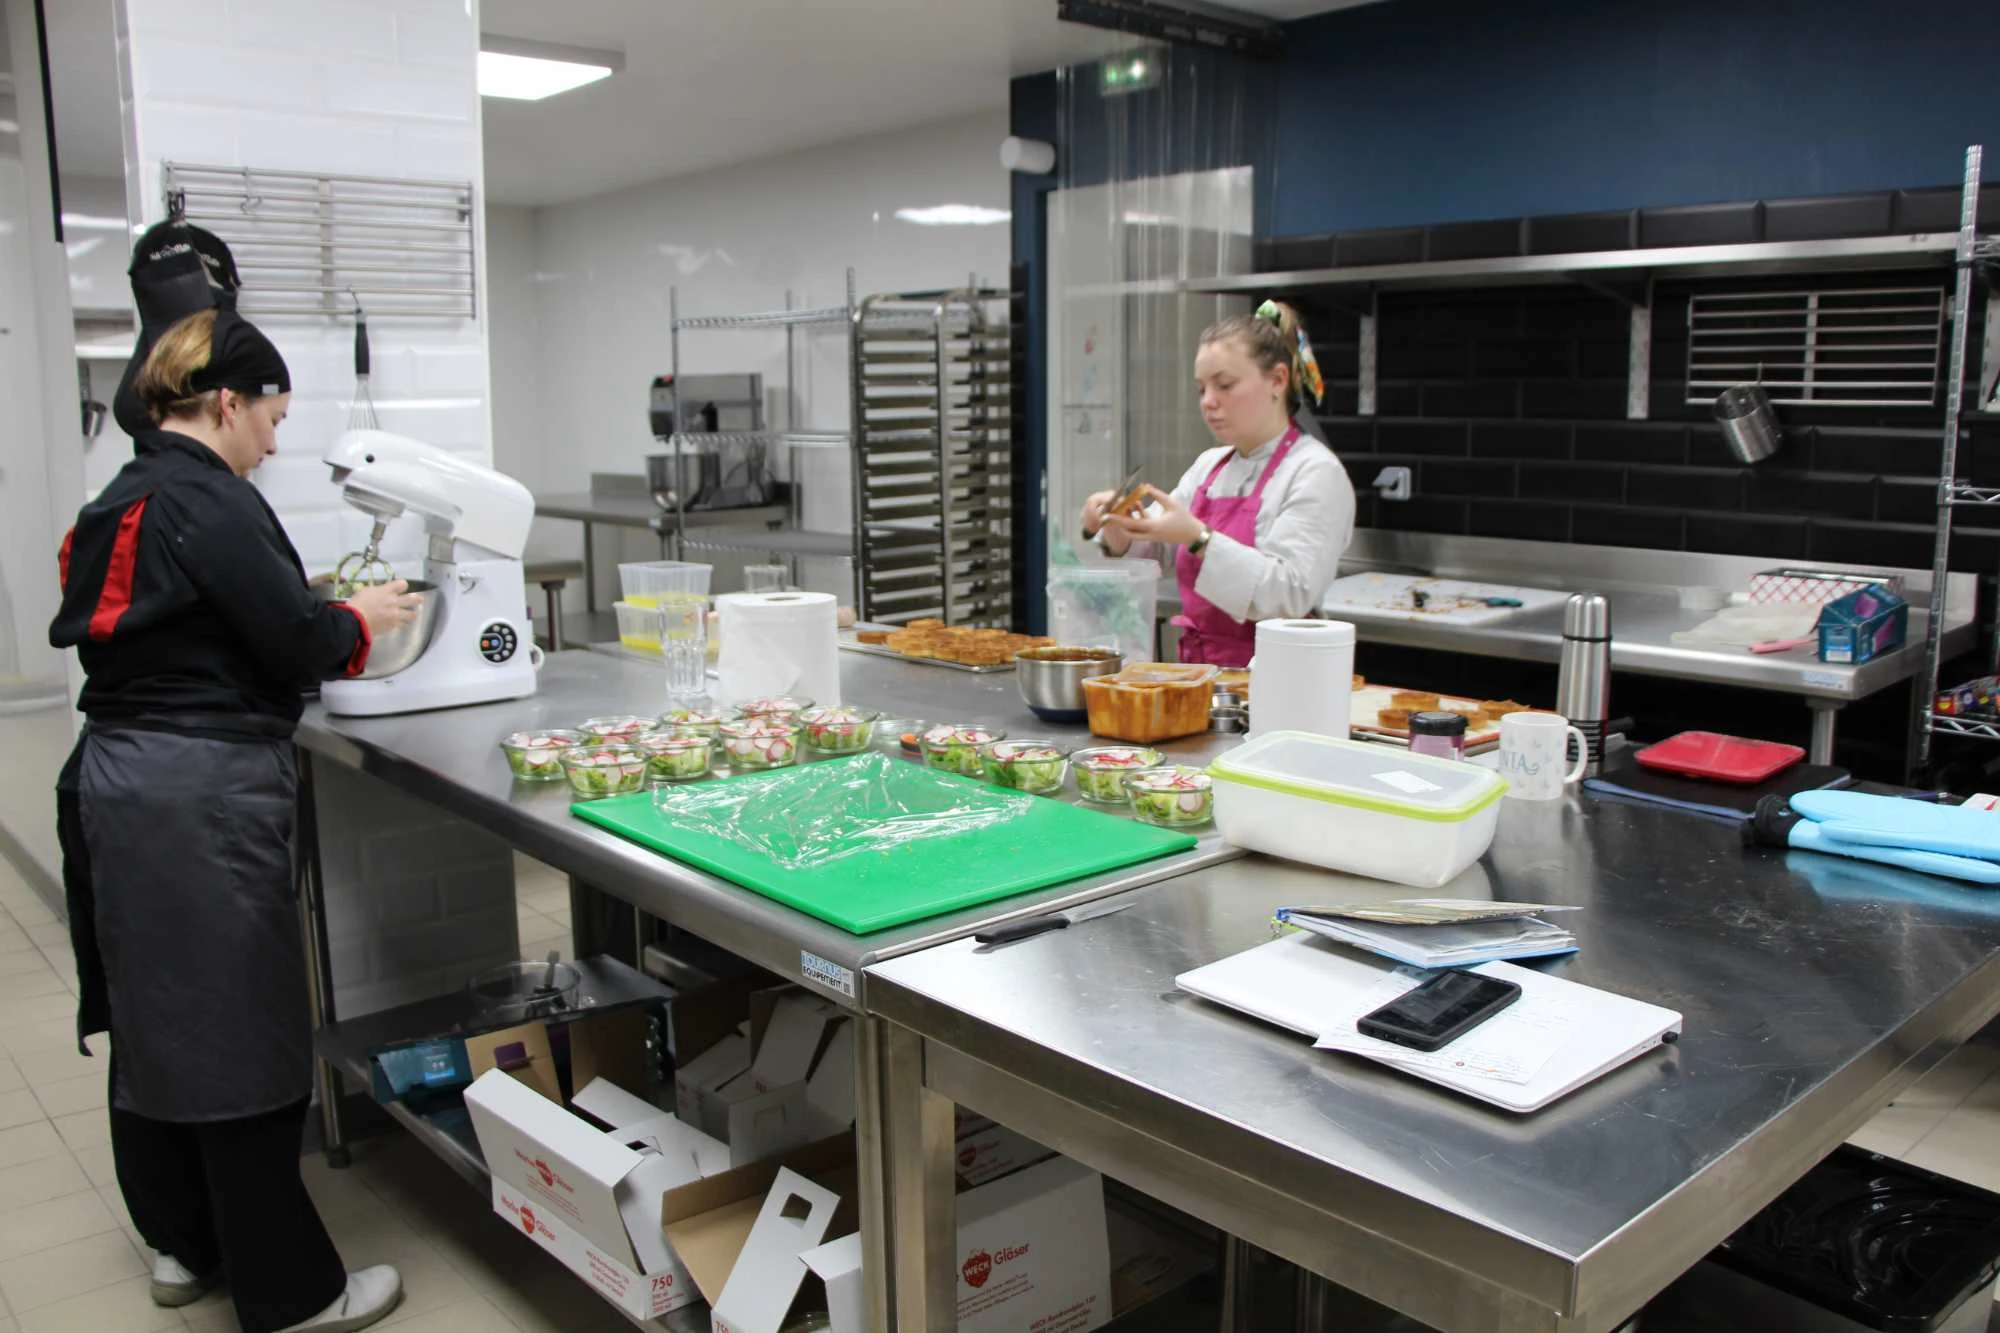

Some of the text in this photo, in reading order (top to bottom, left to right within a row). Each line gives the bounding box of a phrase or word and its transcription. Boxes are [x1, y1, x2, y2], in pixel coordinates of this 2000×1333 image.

[803, 965, 842, 991] EQUIPEMENT
[964, 1242, 1030, 1277] WECK Gläser
[652, 1274, 673, 1292] 750
